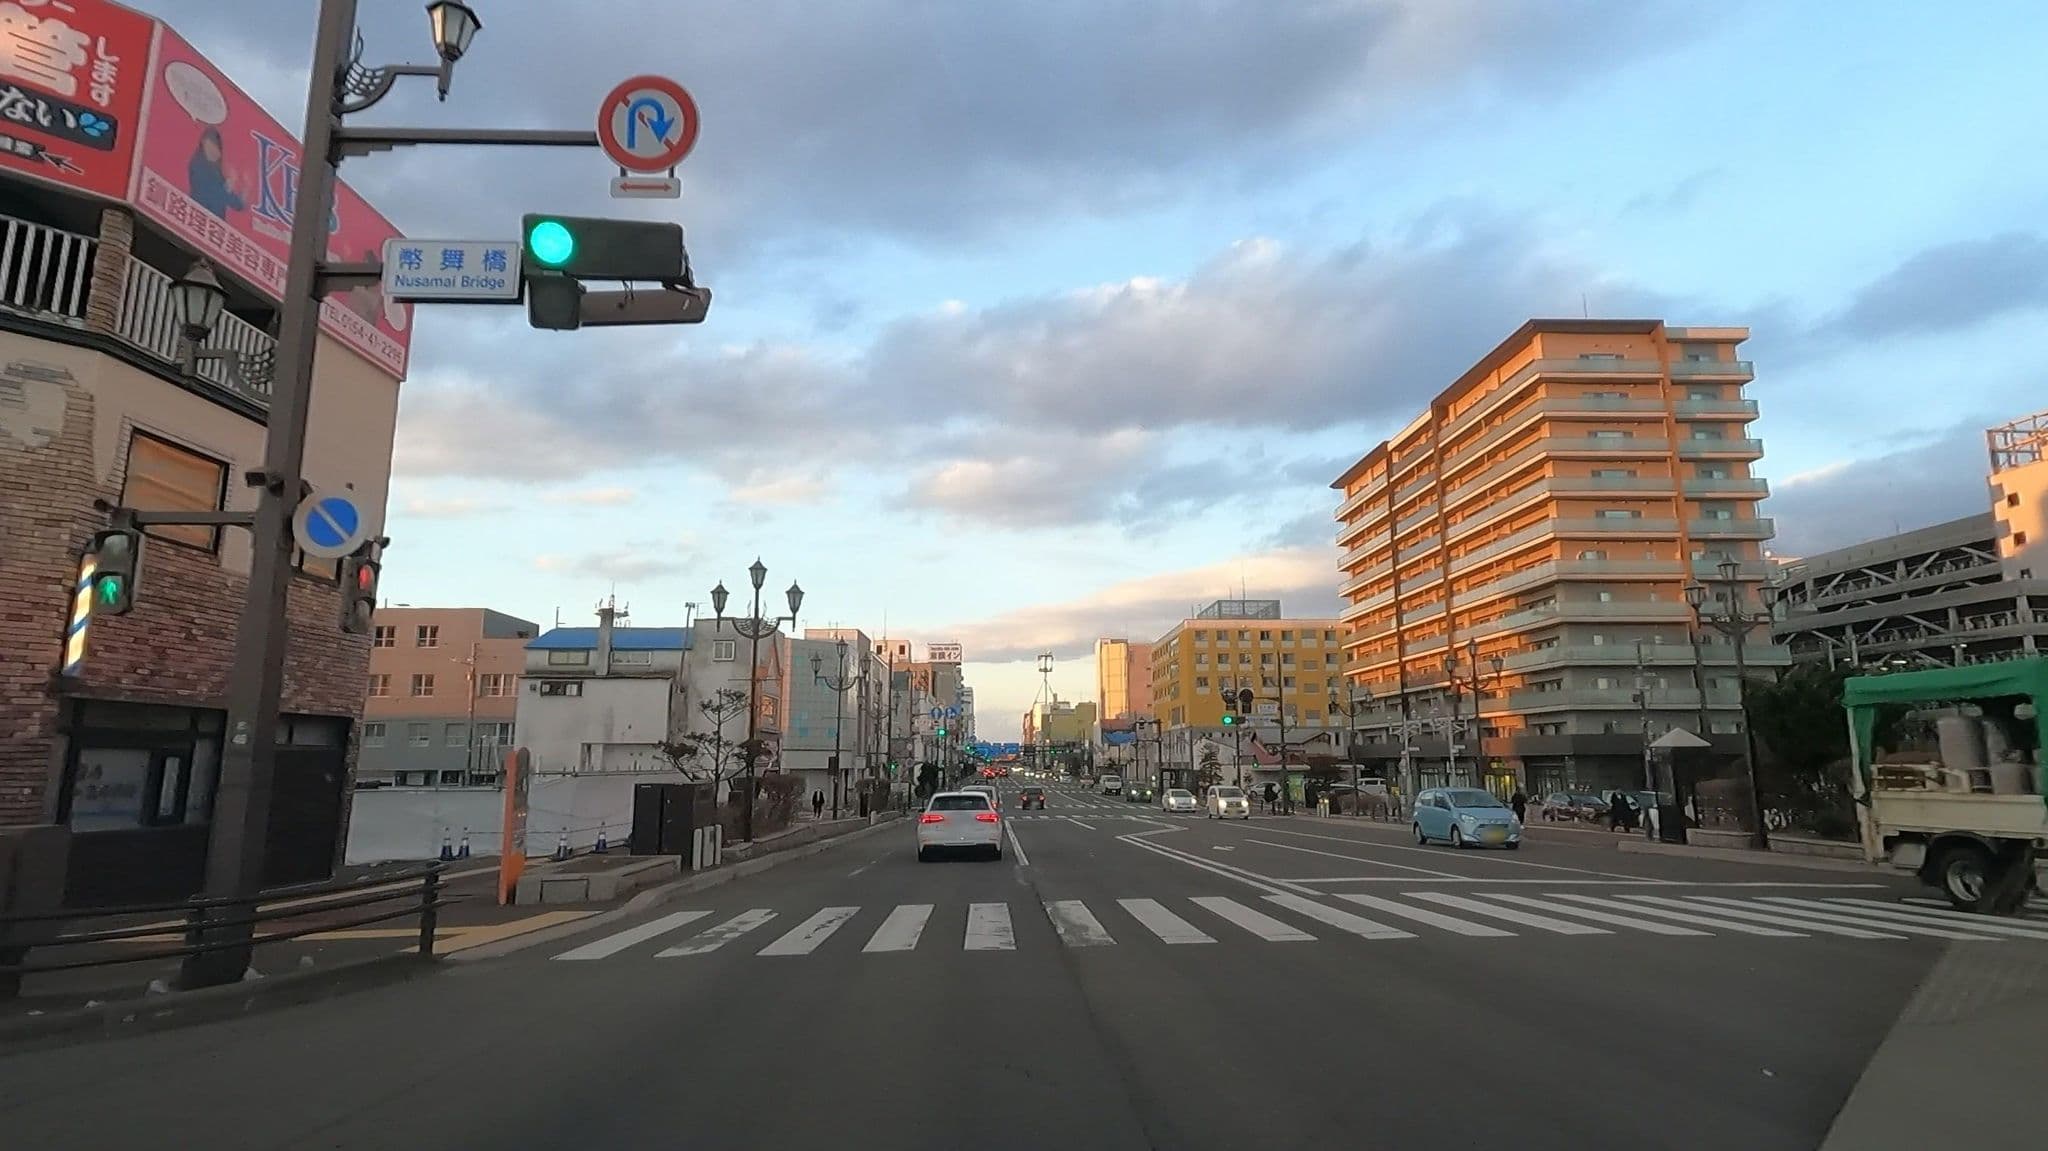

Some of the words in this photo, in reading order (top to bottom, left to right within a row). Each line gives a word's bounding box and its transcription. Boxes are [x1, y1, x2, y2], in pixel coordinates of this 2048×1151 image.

[90, 36, 120, 107] します
[400, 247, 507, 272] 幣舞橋
[395, 274, 456, 288] Nusamai
[461, 275, 505, 290] Bridge
